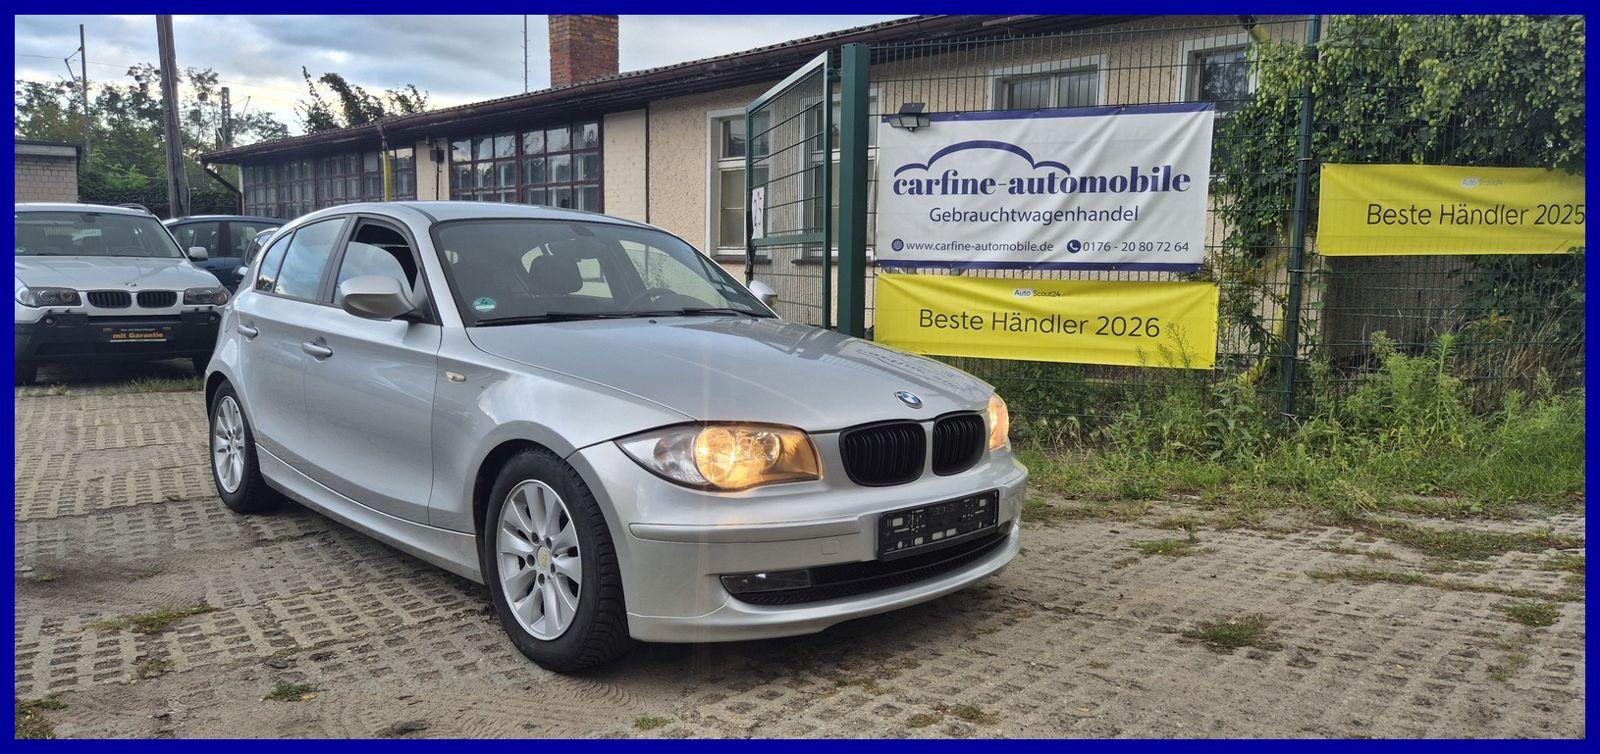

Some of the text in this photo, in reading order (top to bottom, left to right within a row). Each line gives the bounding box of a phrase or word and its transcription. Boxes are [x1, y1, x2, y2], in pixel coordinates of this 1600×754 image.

[893, 165, 1191, 196] carfine-automobile
[929, 205, 1139, 226] Gebrauchtwagenhandel
[1367, 203, 1585, 225] Beste Händler 2025
[906, 240, 1054, 252] www.carfine-automobile.de
[1083, 241, 1111, 252] 0176
[1121, 241, 1136, 252] 20
[1138, 241, 1153, 252] 80
[1157, 241, 1171, 252] 72
[1174, 241, 1190, 252] 64
[1014, 289, 1031, 297] Auto
[919, 308, 1160, 338] Beste Händler 2026
[128, 331, 164, 339] Garantie
